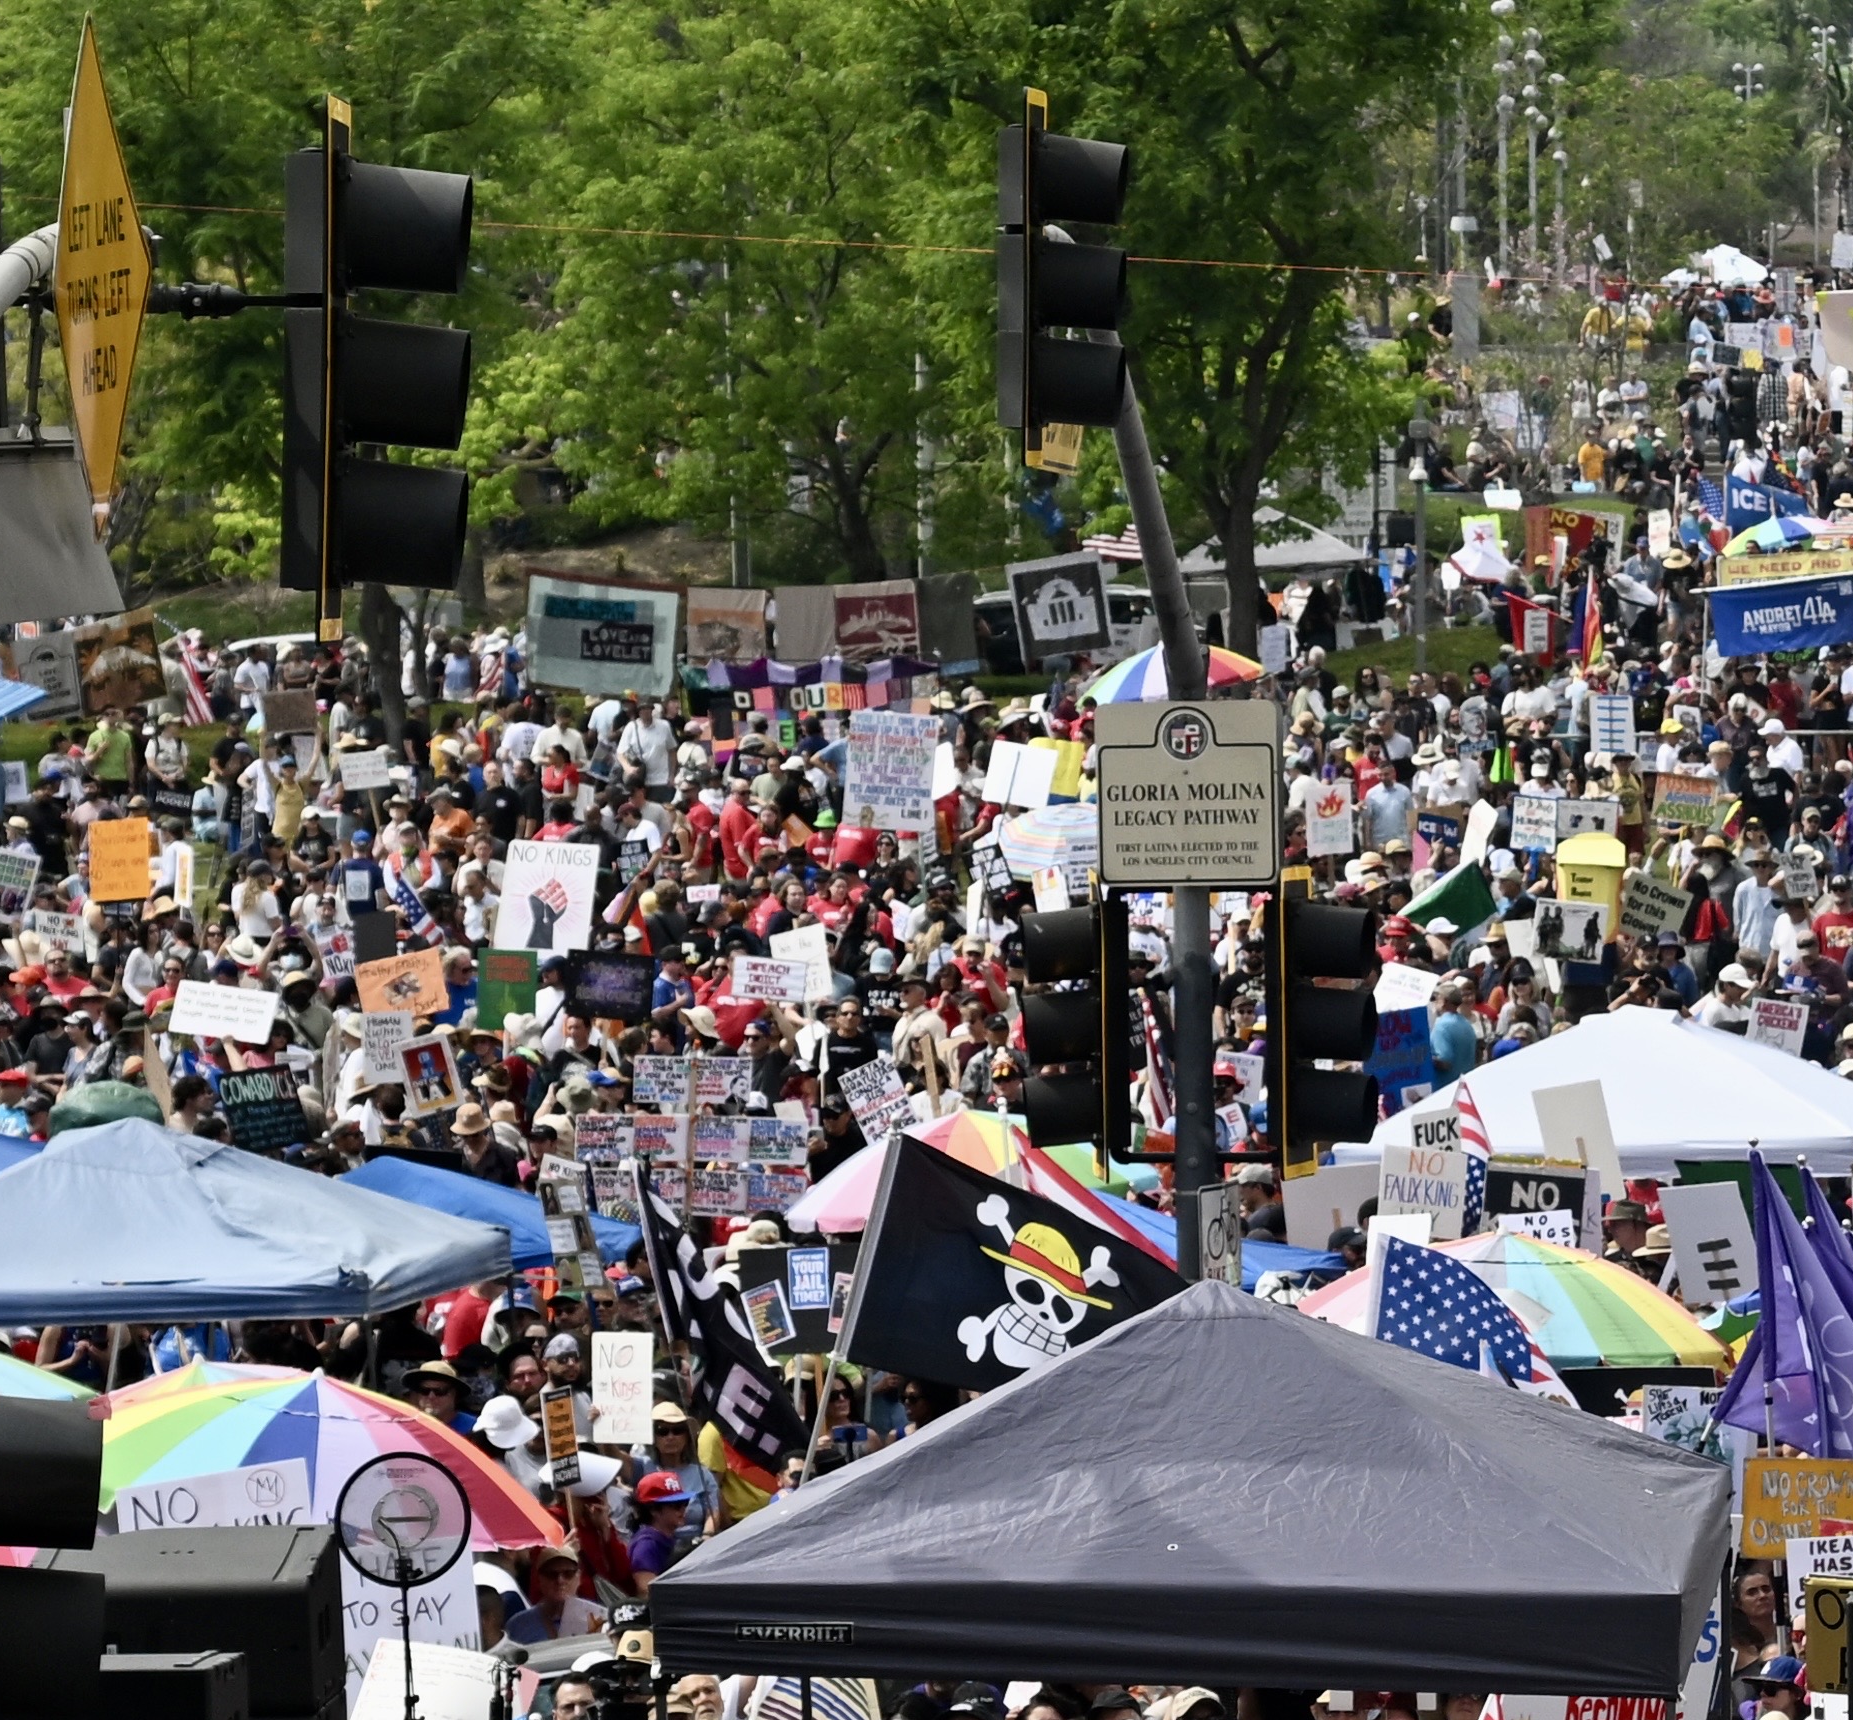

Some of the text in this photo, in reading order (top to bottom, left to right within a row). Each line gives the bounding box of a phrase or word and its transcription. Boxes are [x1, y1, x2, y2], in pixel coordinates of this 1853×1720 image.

[67, 197, 126, 253] LEFT LANE
[67, 268, 131, 327] TURNS LEFT
[82, 344, 117, 397] AHEAD
[1106, 782, 1265, 801] GLORIA MOLINA
[1114, 808, 1260, 827] LEGACY PATHWAY
[739, 1623, 851, 1644] EVERBILT
